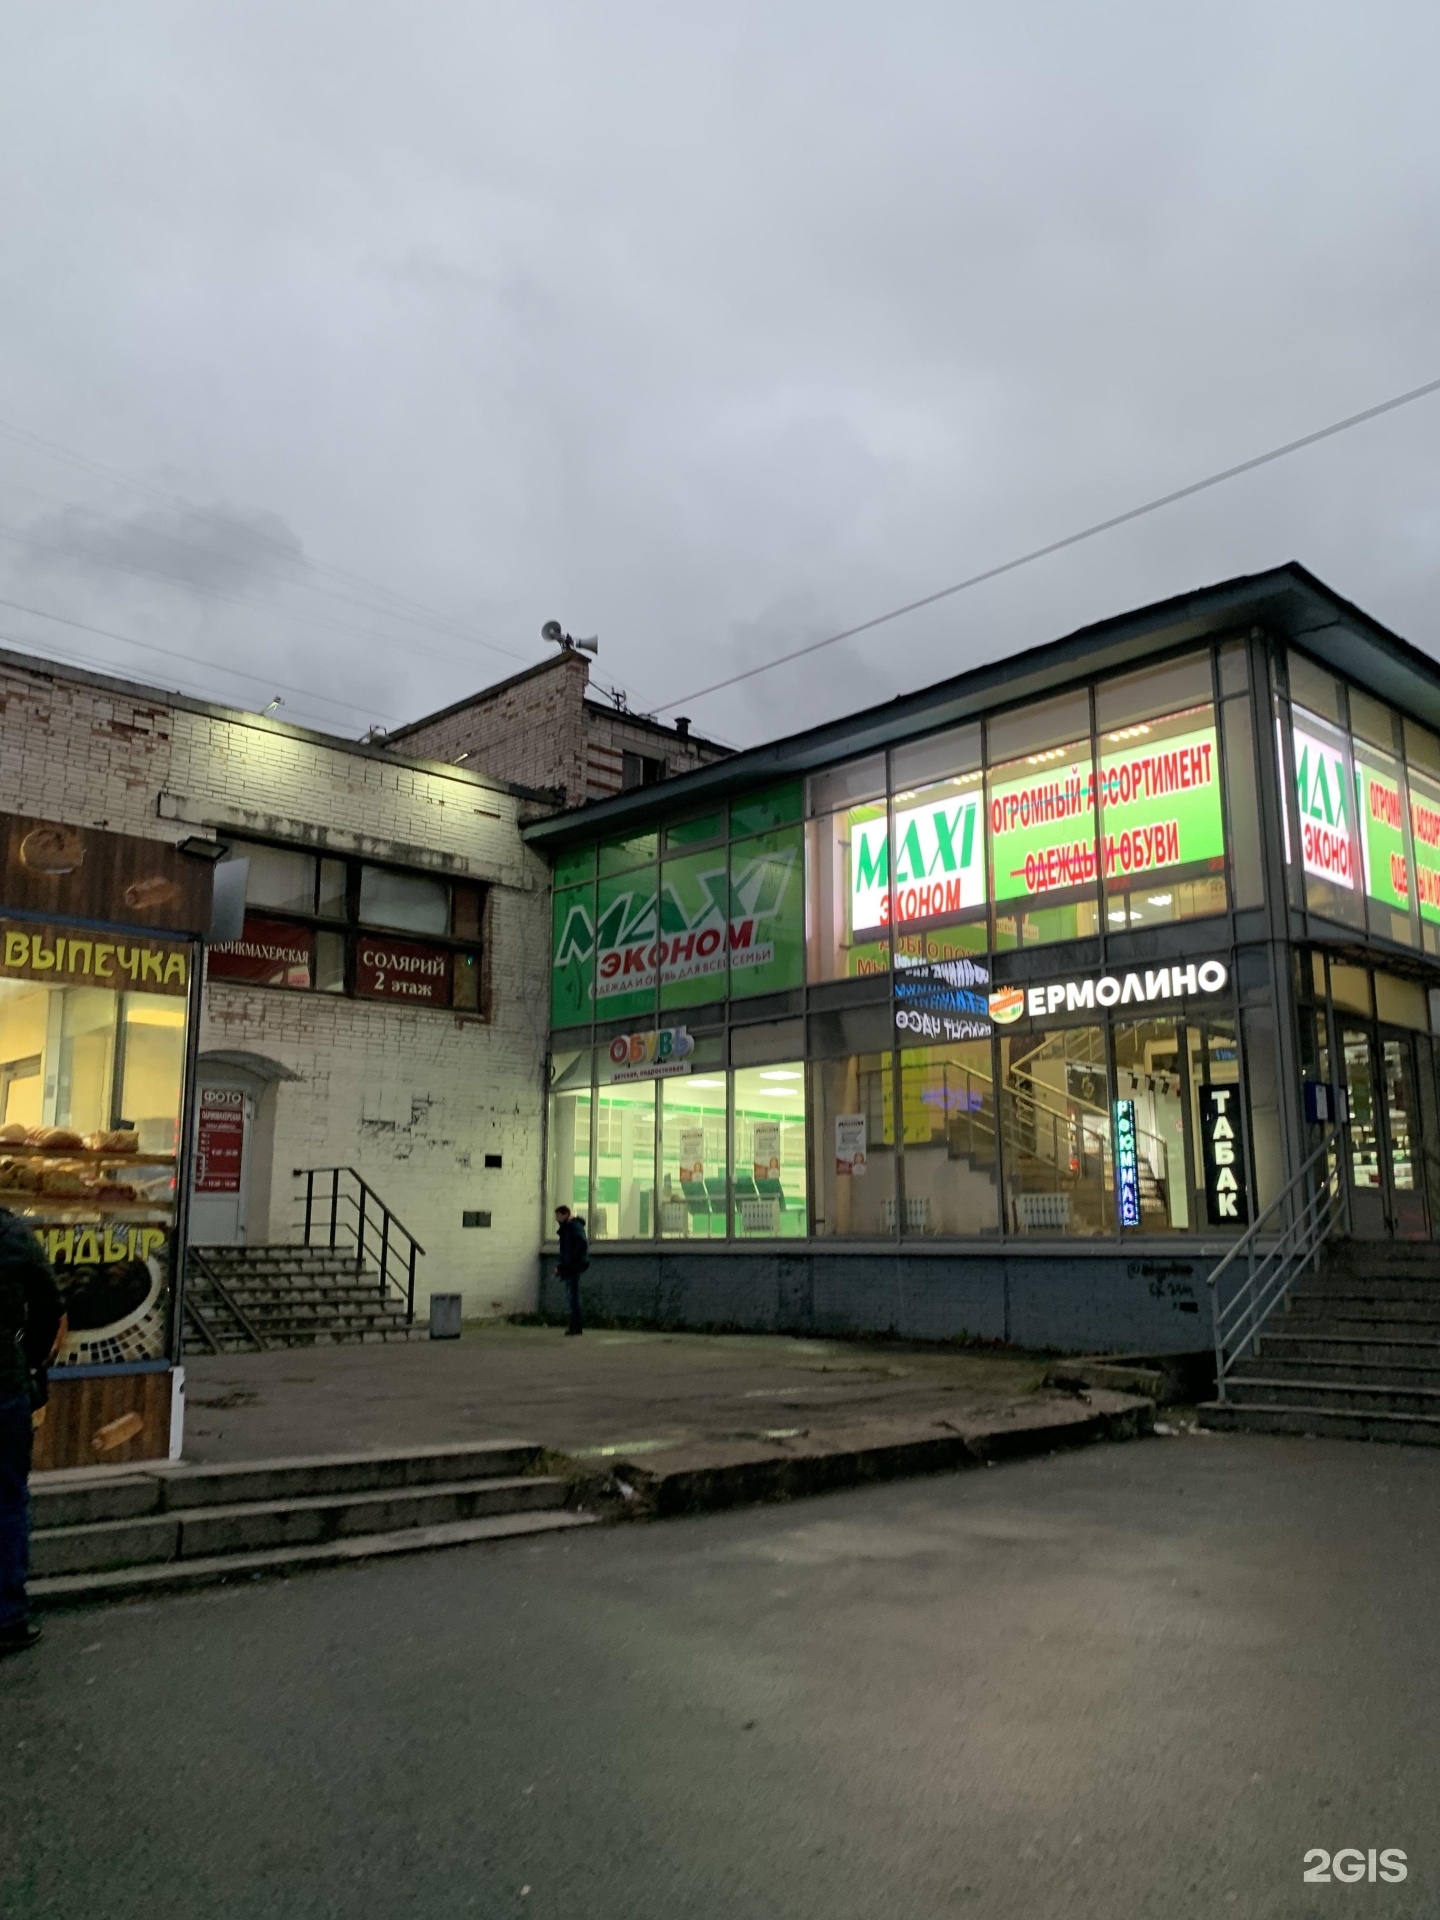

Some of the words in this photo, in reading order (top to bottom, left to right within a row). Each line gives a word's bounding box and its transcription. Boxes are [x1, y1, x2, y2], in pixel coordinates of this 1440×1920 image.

[992, 766, 1082, 834] ОГРОМНЫЙ
[1087, 744, 1212, 812] АССОРТИМЕНТ
[856, 802, 977, 893] MAXI
[1102, 836, 1115, 876] И
[1120, 822, 1179, 872] ОБУВИ
[555, 845, 797, 966] MAXI
[879, 877, 961, 926] ЭКОНОМ
[5, 931, 186, 985] ВЫПЕЧКА
[363, 950, 446, 977] СОЛЯРИЙ
[600, 919, 754, 979] ЭКОНОМ
[636, 977, 643, 987] И
[679, 965, 701, 979] ДЛЯ
[733, 949, 771, 966] СЕМЬИ
[374, 971, 384, 990] 2
[392, 980, 432, 997] этаж
[1028, 960, 1227, 1017] ЕРМОЛИНО
[610, 1026, 690, 1063] ОБУВЬ
[204, 1091, 241, 1104] ФОТО
[1211, 1090, 1239, 1217] ТАБАК
[35, 1228, 166, 1265] НДЫР
